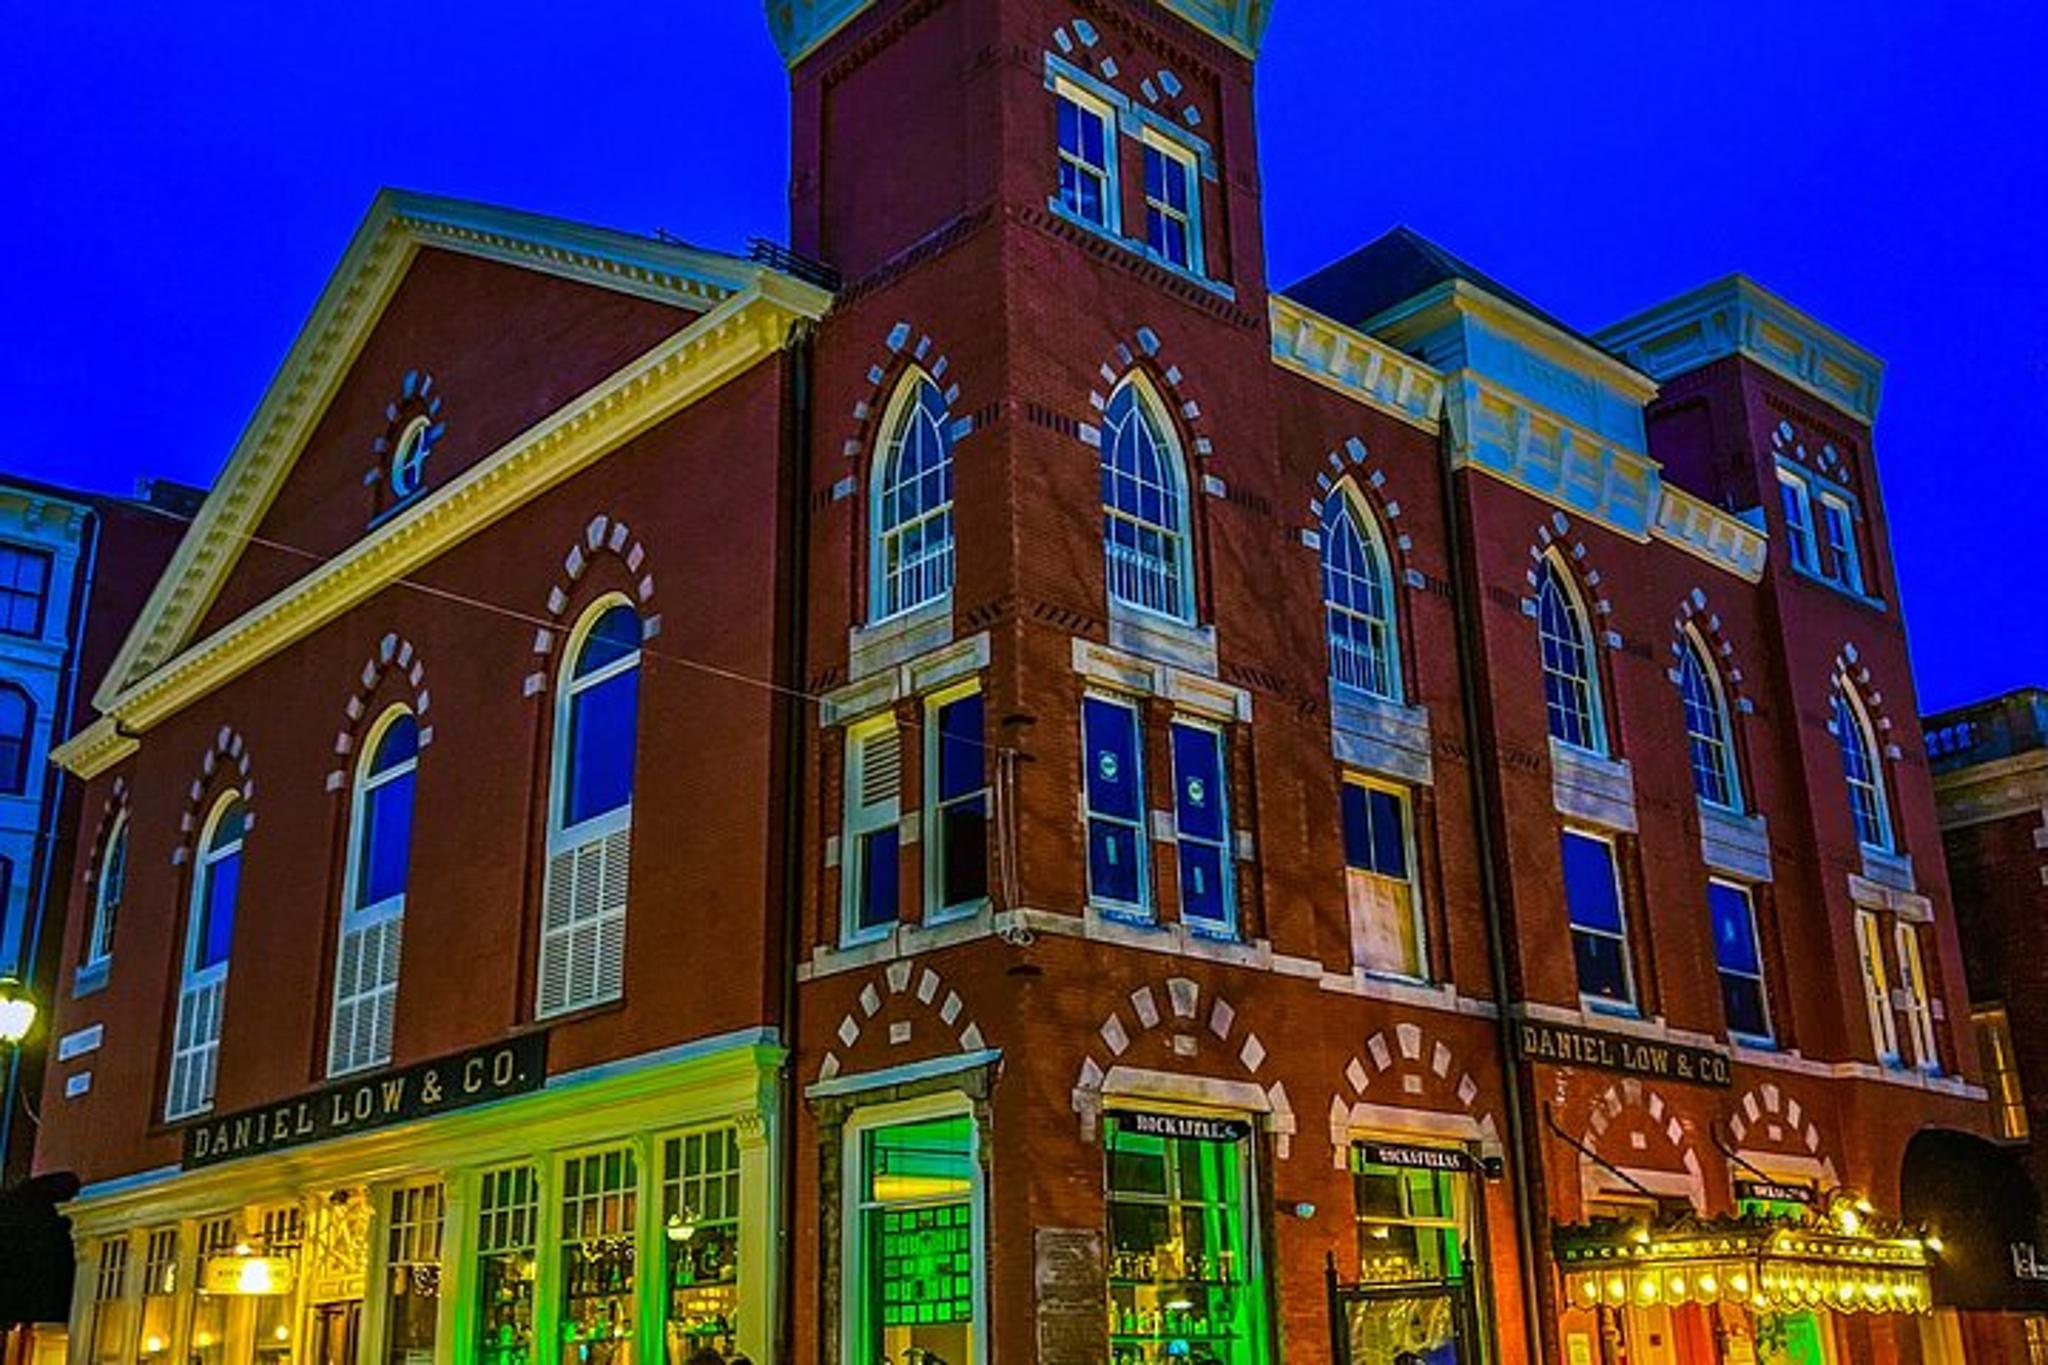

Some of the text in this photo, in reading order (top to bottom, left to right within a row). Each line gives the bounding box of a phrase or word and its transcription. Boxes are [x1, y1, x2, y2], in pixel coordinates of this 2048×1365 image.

[1522, 1026, 1731, 1084] DANIEL LOW & CO.
[194, 1049, 526, 1159] DANIEL LOW & CO.
[1566, 1239, 1748, 1260] ROCKAFLAS
